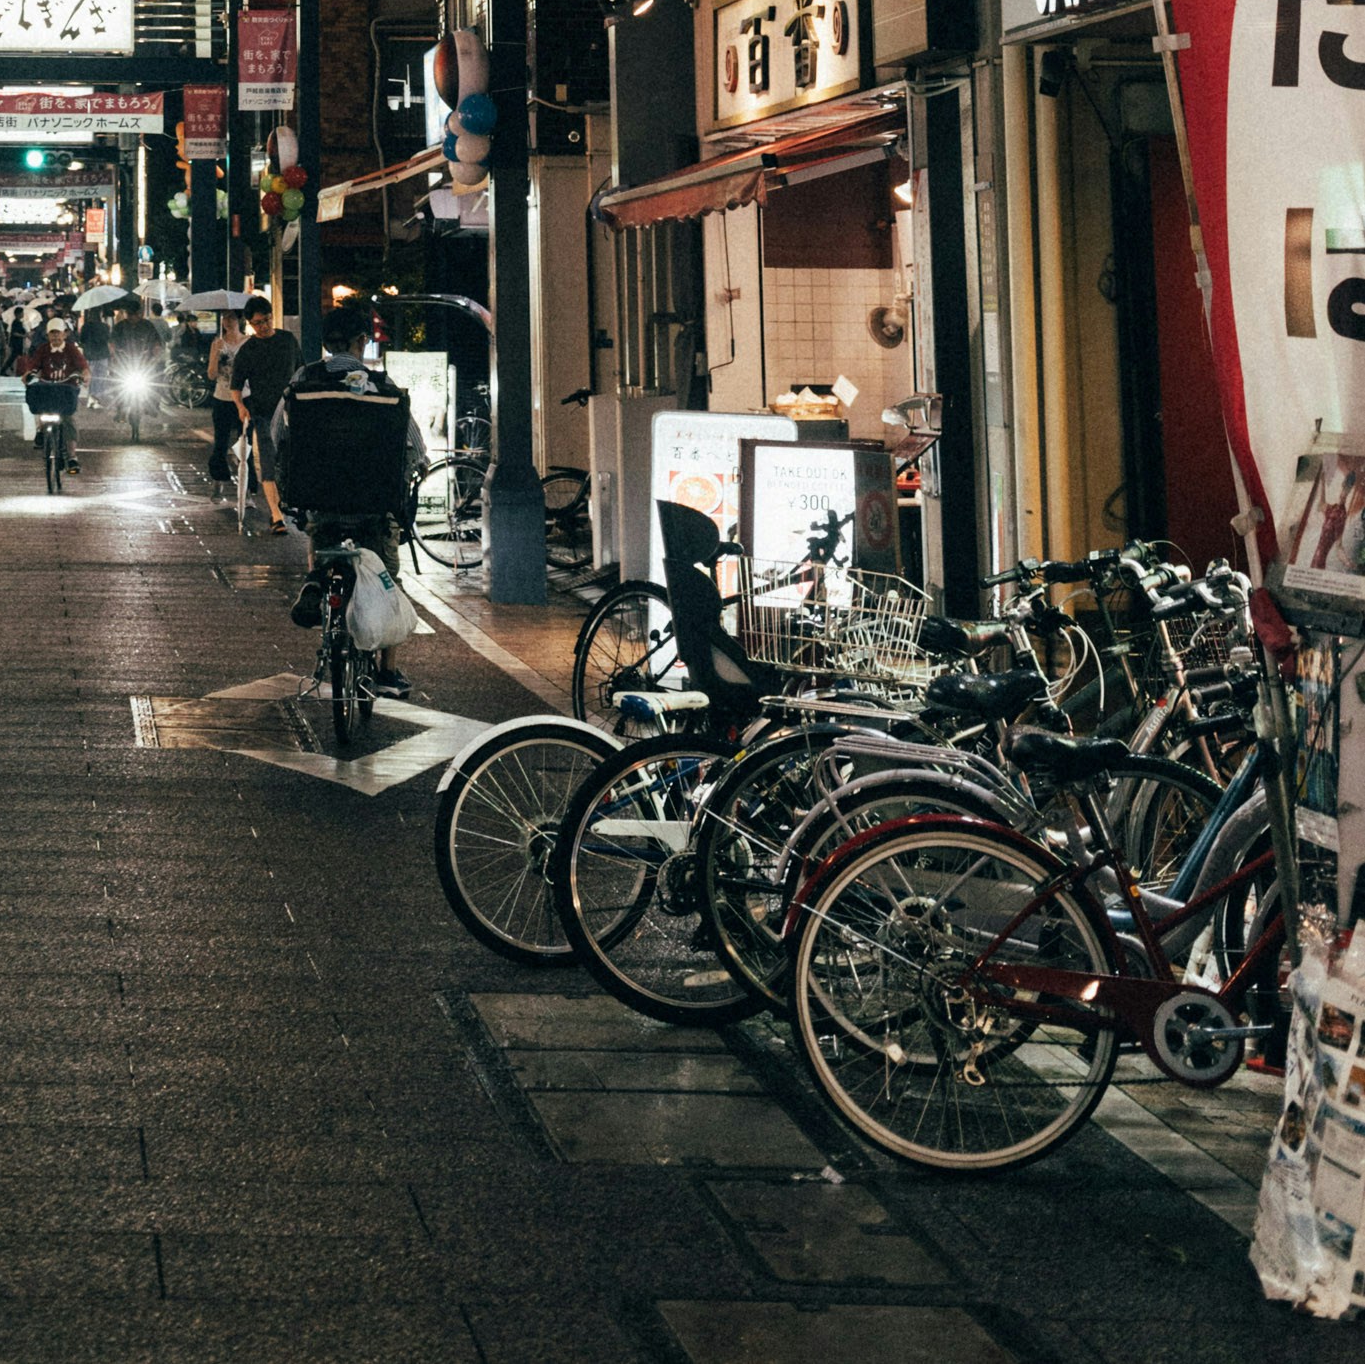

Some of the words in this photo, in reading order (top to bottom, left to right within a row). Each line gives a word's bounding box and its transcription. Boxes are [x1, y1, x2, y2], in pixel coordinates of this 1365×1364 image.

[39, 97, 157, 111] 街を、家でまもろう。
[27, 117, 93, 129] パナソニック
[96, 117, 141, 129] ホームズ
[773, 465, 802, 478] TAKE
[806, 467, 828, 479] OUT
[833, 468, 848, 480] OK
[788, 494, 830, 511] ¥300
